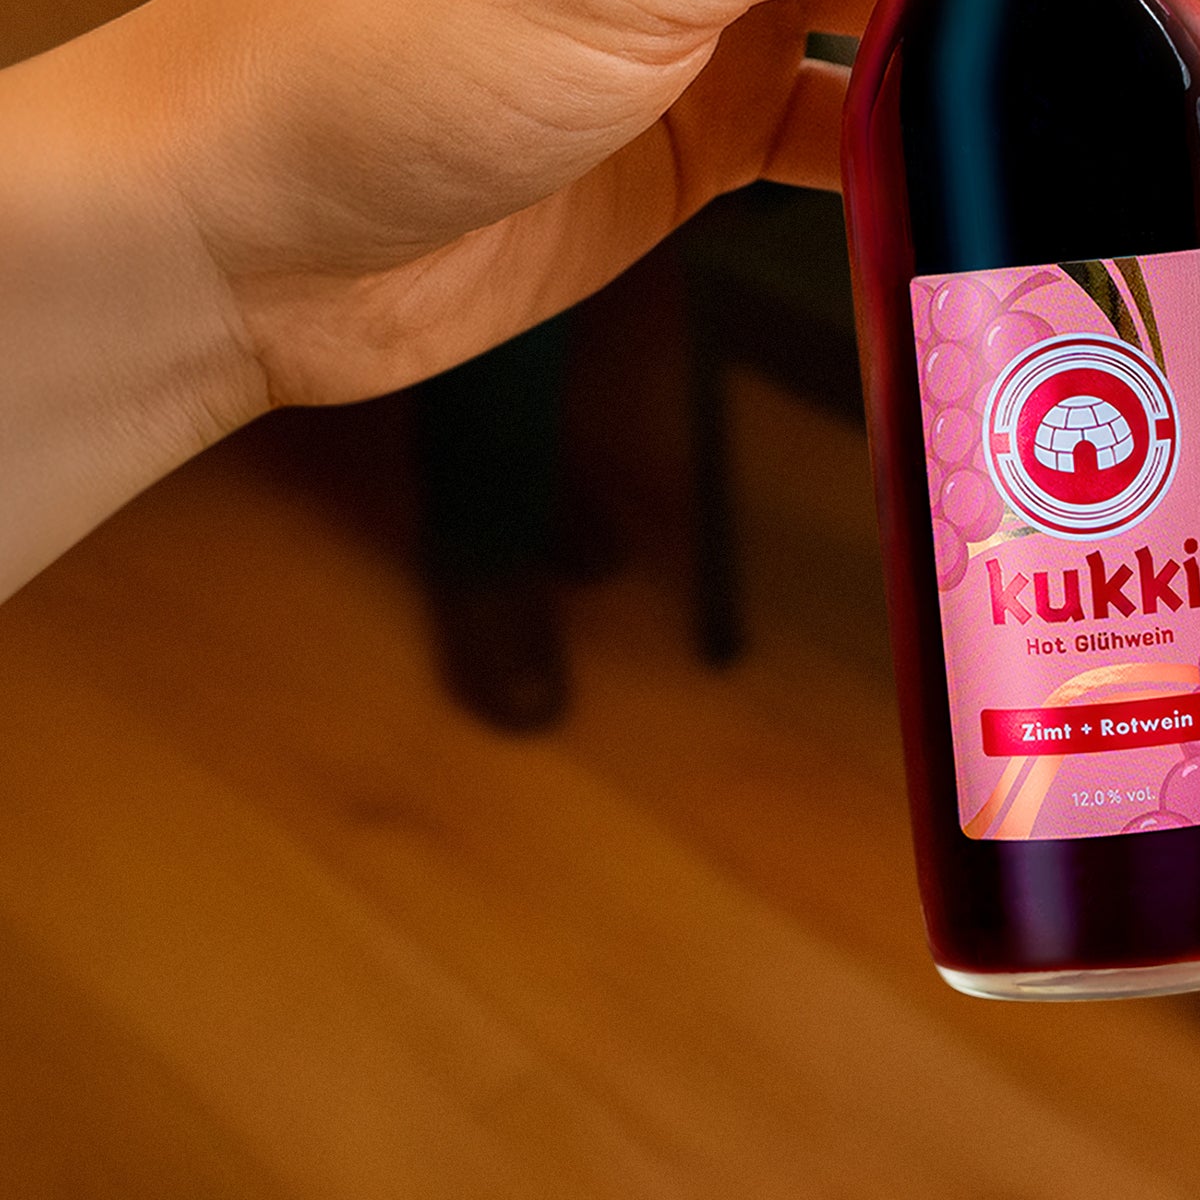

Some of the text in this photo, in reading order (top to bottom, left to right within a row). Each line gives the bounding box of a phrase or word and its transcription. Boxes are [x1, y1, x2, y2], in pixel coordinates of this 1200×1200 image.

[1026, 627, 1174, 655] Hot Glühwein
[1021, 722, 1072, 741] Zimt
[1100, 709, 1193, 736] Rotwein
[1126, 786, 1156, 801] vol.
